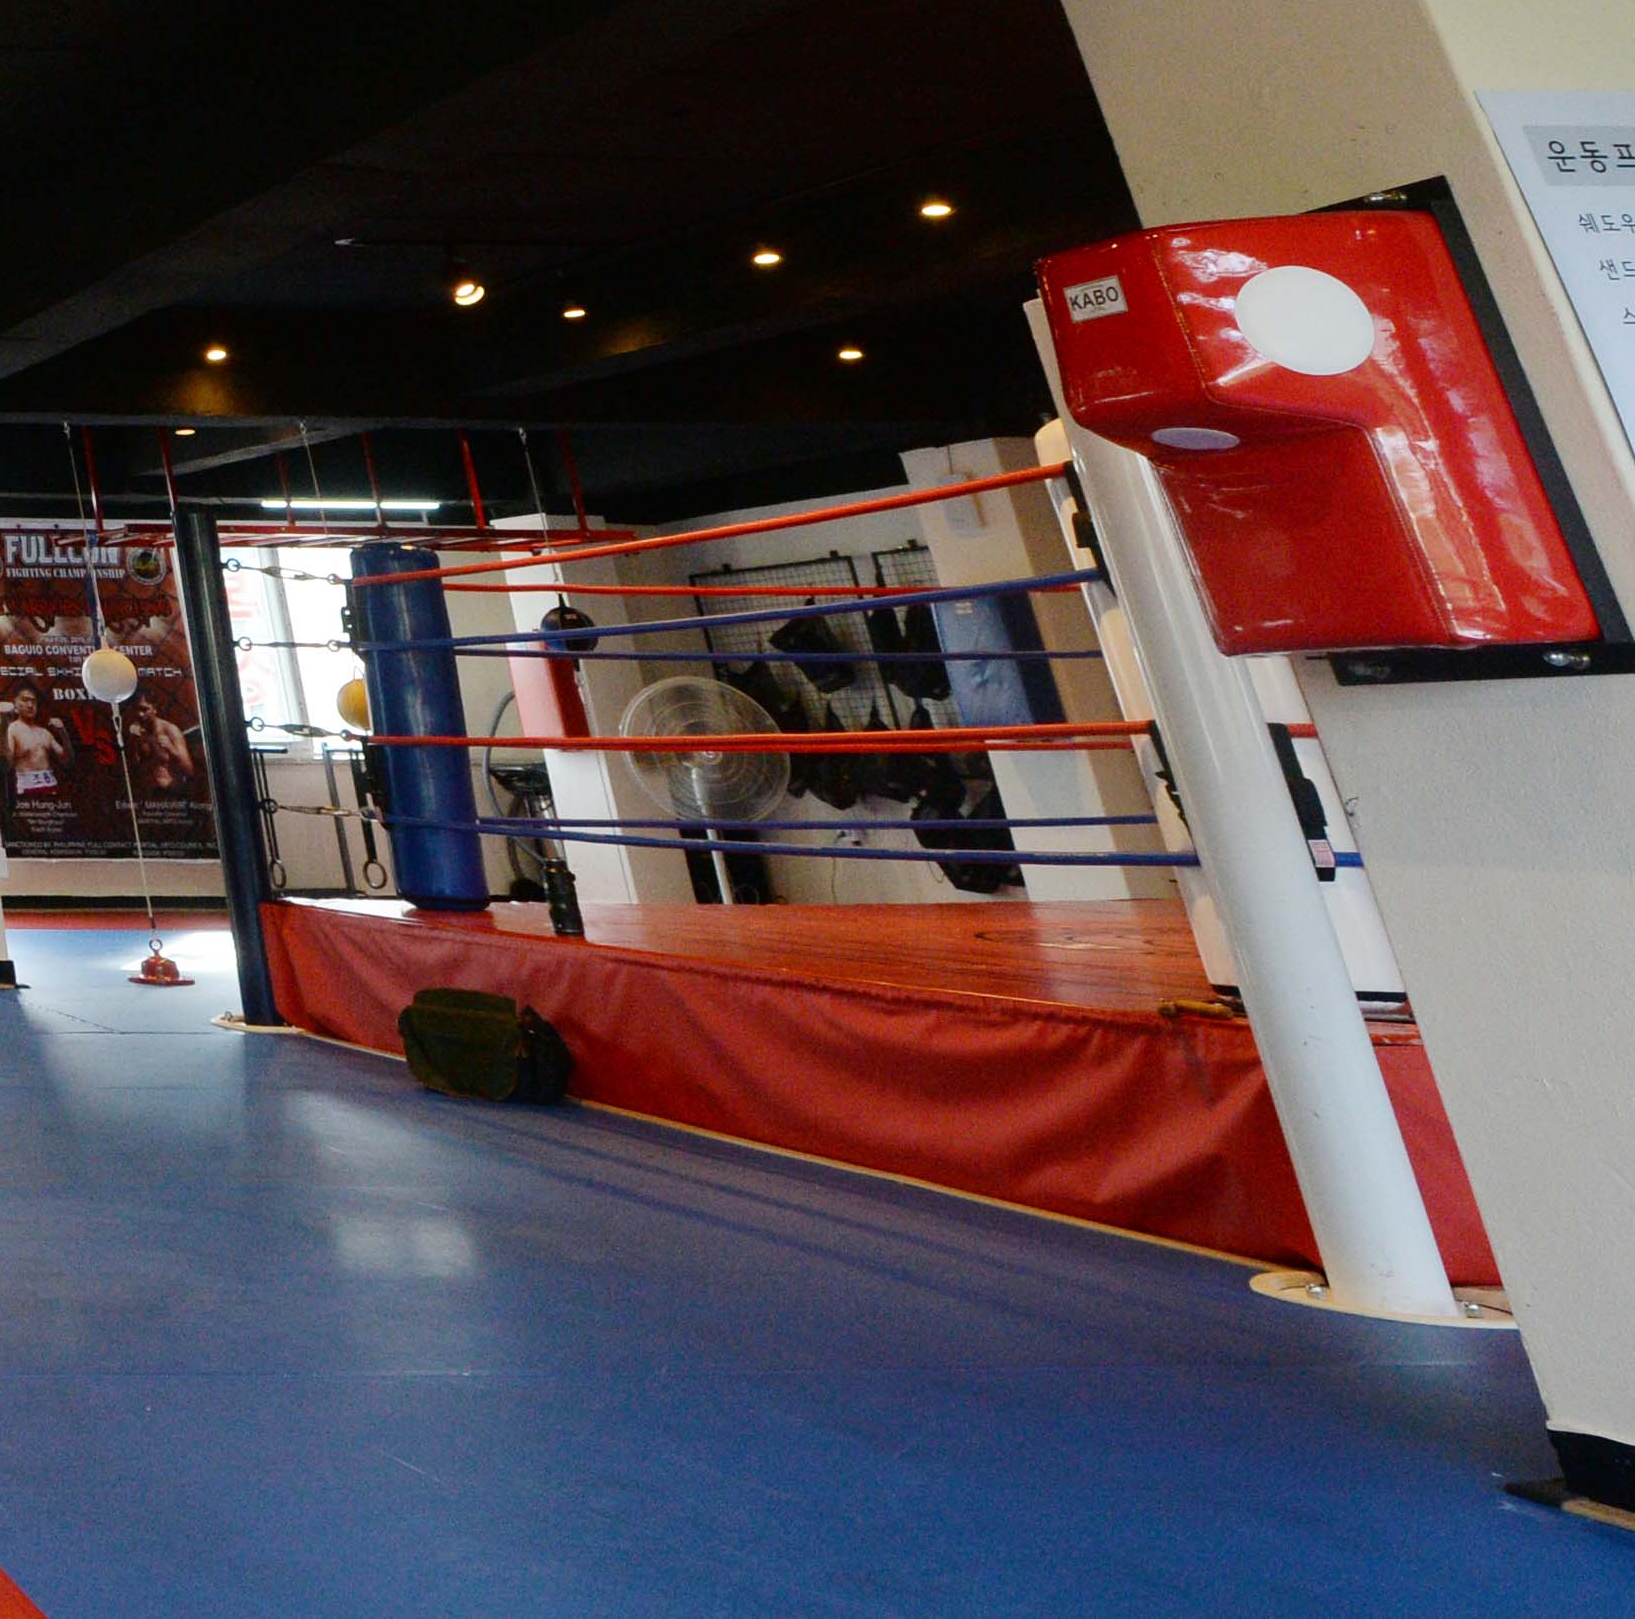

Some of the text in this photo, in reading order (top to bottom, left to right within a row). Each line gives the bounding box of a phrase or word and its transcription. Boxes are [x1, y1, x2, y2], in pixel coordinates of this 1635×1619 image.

[1547, 140, 1635, 174] 운동프
[1069, 286, 1119, 311] KABO
[6, 568, 52, 579] FIGHTING
[4, 645, 44, 655] BAGUIO
